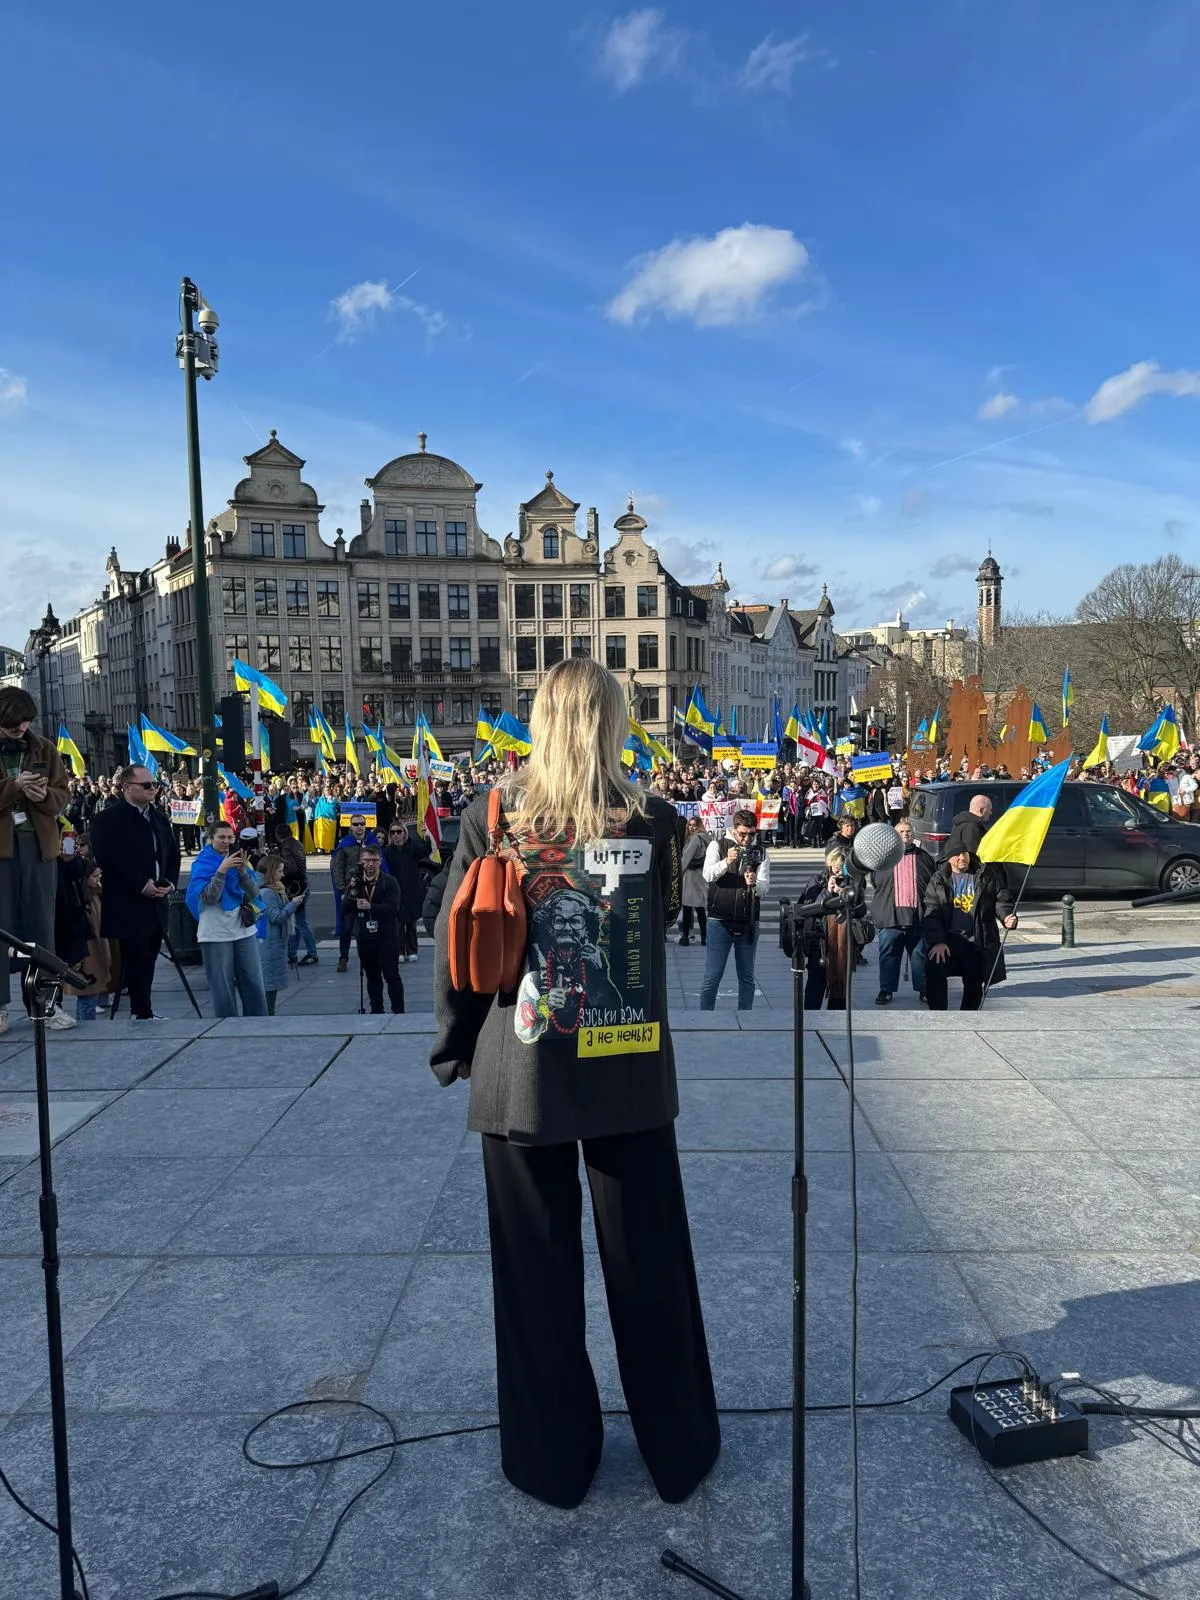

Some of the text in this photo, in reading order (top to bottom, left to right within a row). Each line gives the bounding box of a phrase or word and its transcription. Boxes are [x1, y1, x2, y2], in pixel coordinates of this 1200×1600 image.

[699, 802, 726, 816] WAKE
[594, 850, 643, 864] WTF?
[598, 1031, 613, 1044] не
[617, 1026, 653, 1043] неньку
